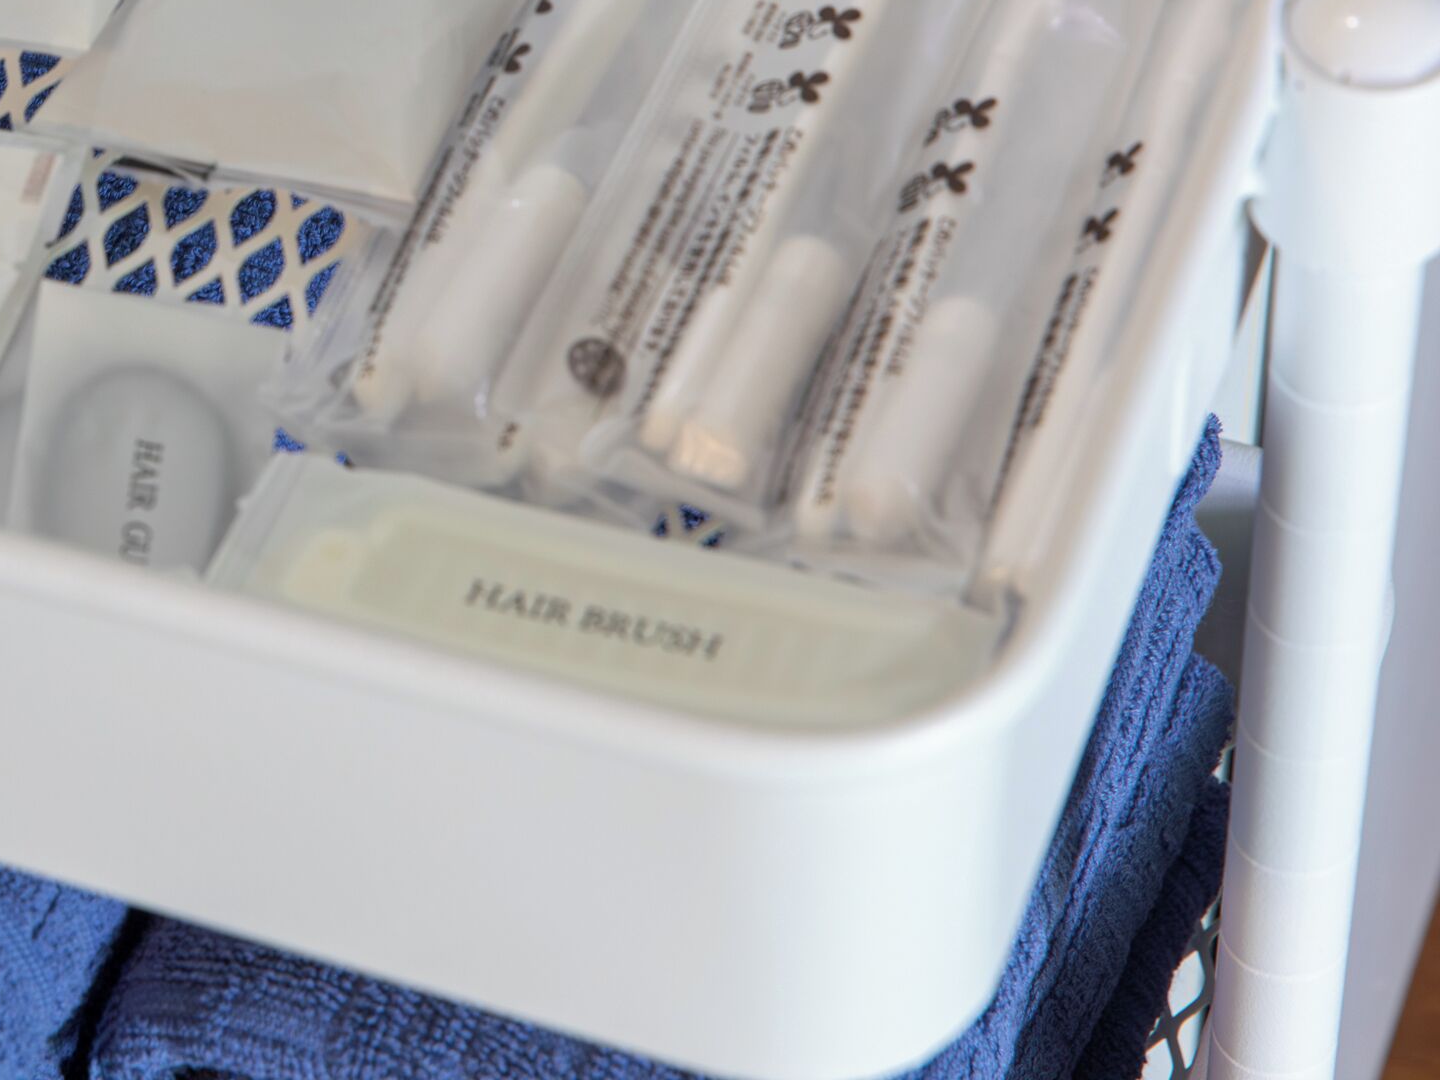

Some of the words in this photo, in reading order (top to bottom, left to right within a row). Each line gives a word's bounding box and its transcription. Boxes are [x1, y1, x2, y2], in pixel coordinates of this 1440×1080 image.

[128, 438, 164, 512] HAIR
[117, 520, 150, 567] GU
[465, 578, 573, 628] HAIR
[579, 604, 723, 659] BRUSH
